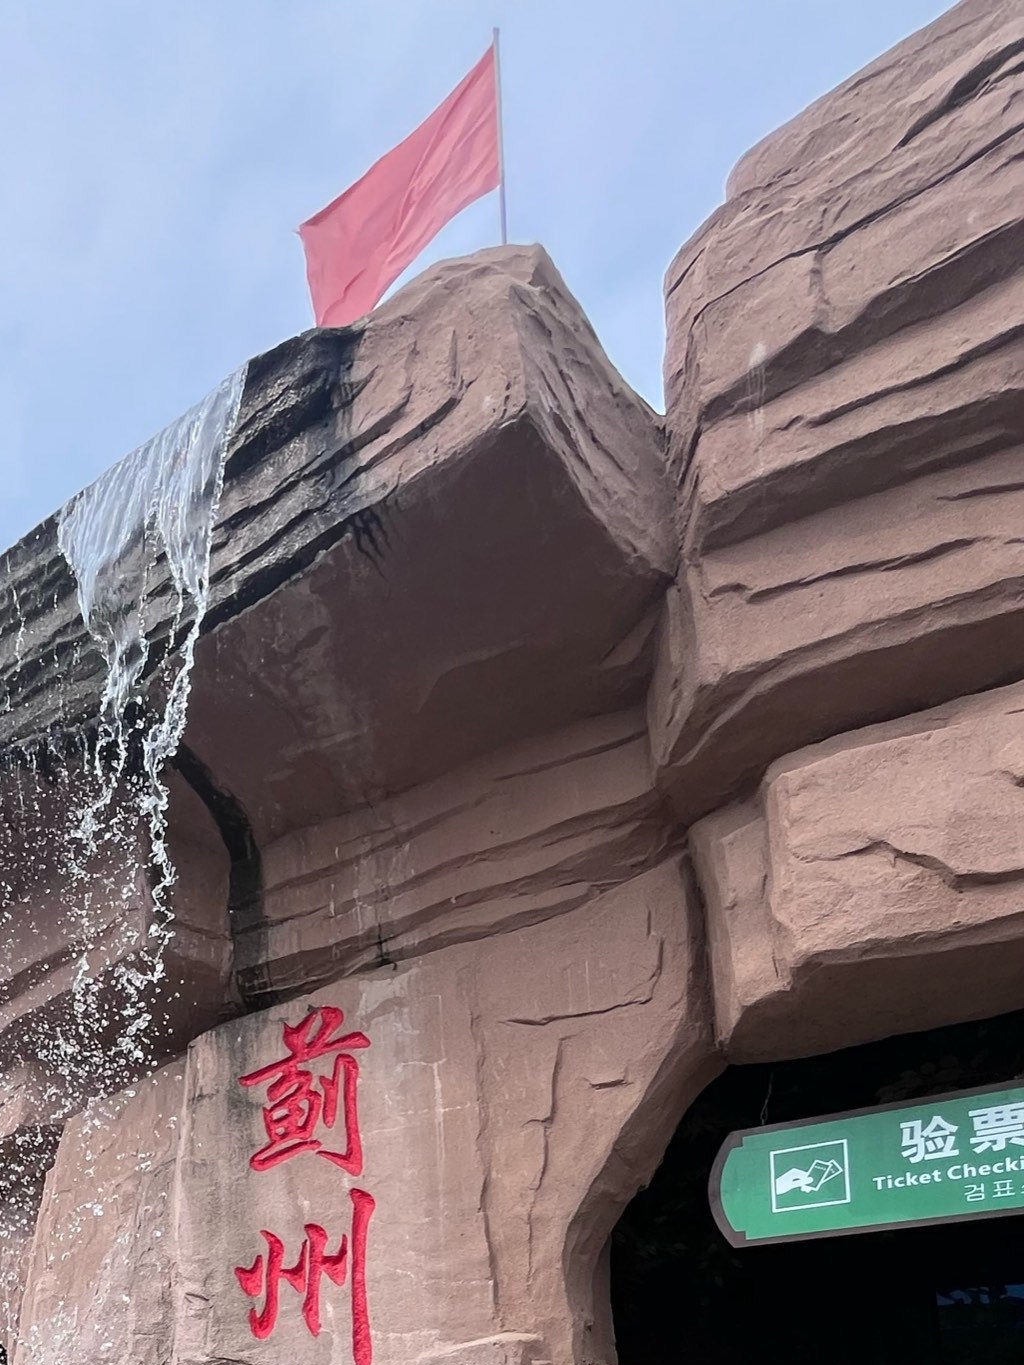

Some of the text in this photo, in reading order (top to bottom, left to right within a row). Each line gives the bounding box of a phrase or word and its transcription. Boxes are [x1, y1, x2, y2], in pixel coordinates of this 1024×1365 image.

[900, 1100, 1024, 1163] 验票
[872, 1168, 942, 1190] Ticket
[964, 1178, 1024, 1202] 검표
